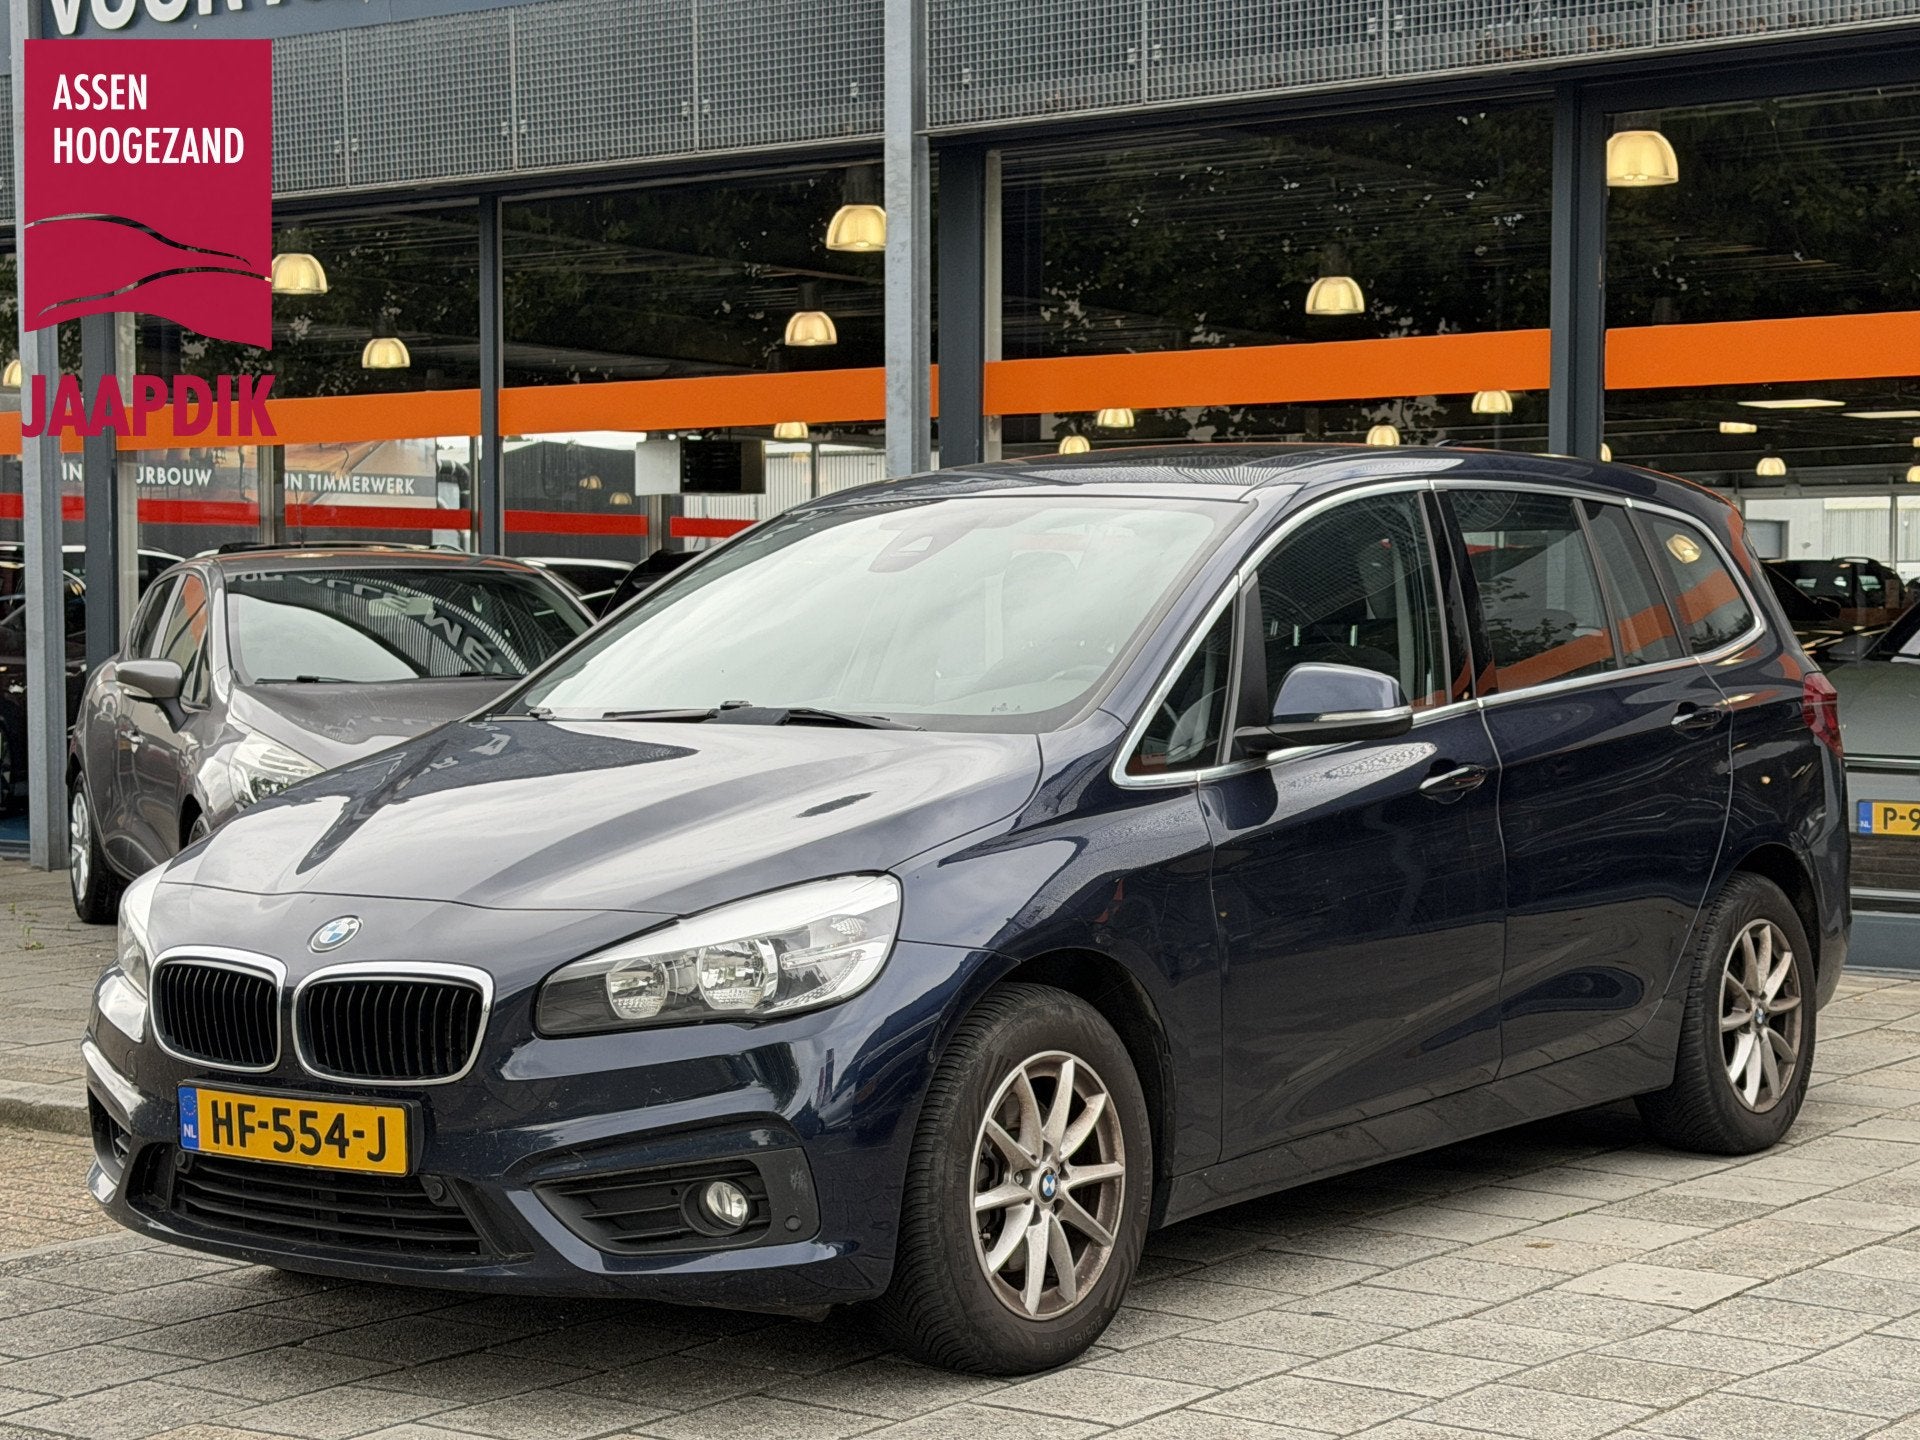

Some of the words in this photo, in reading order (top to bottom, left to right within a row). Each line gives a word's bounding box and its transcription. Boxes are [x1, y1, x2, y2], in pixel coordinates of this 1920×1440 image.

[308, 473, 415, 495] TIMMERWERK
[1860, 820, 1871, 829] NL
[1883, 807, 1920, 831] P-9
[183, 1123, 197, 1139] NL
[211, 1100, 386, 1163] HF-554-J
